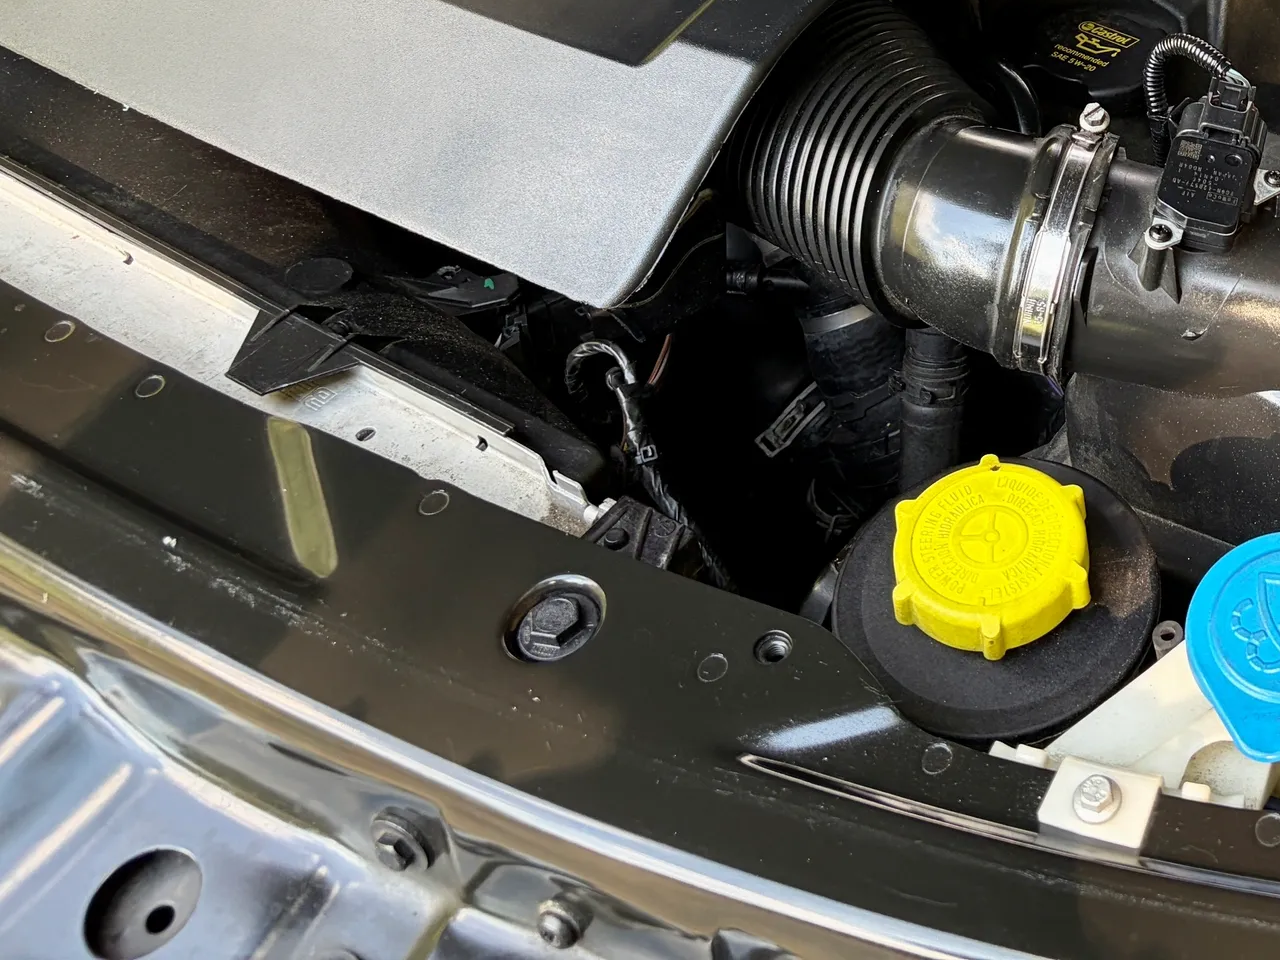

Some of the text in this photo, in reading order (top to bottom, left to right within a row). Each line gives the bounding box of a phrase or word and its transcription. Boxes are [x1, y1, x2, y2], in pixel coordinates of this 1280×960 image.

[1090, 27, 1131, 45] Castrol
[1051, 51, 1069, 62] SAE
[1054, 44, 1110, 67] recommended
[919, 485, 972, 595] POWER STEERING FLUID
